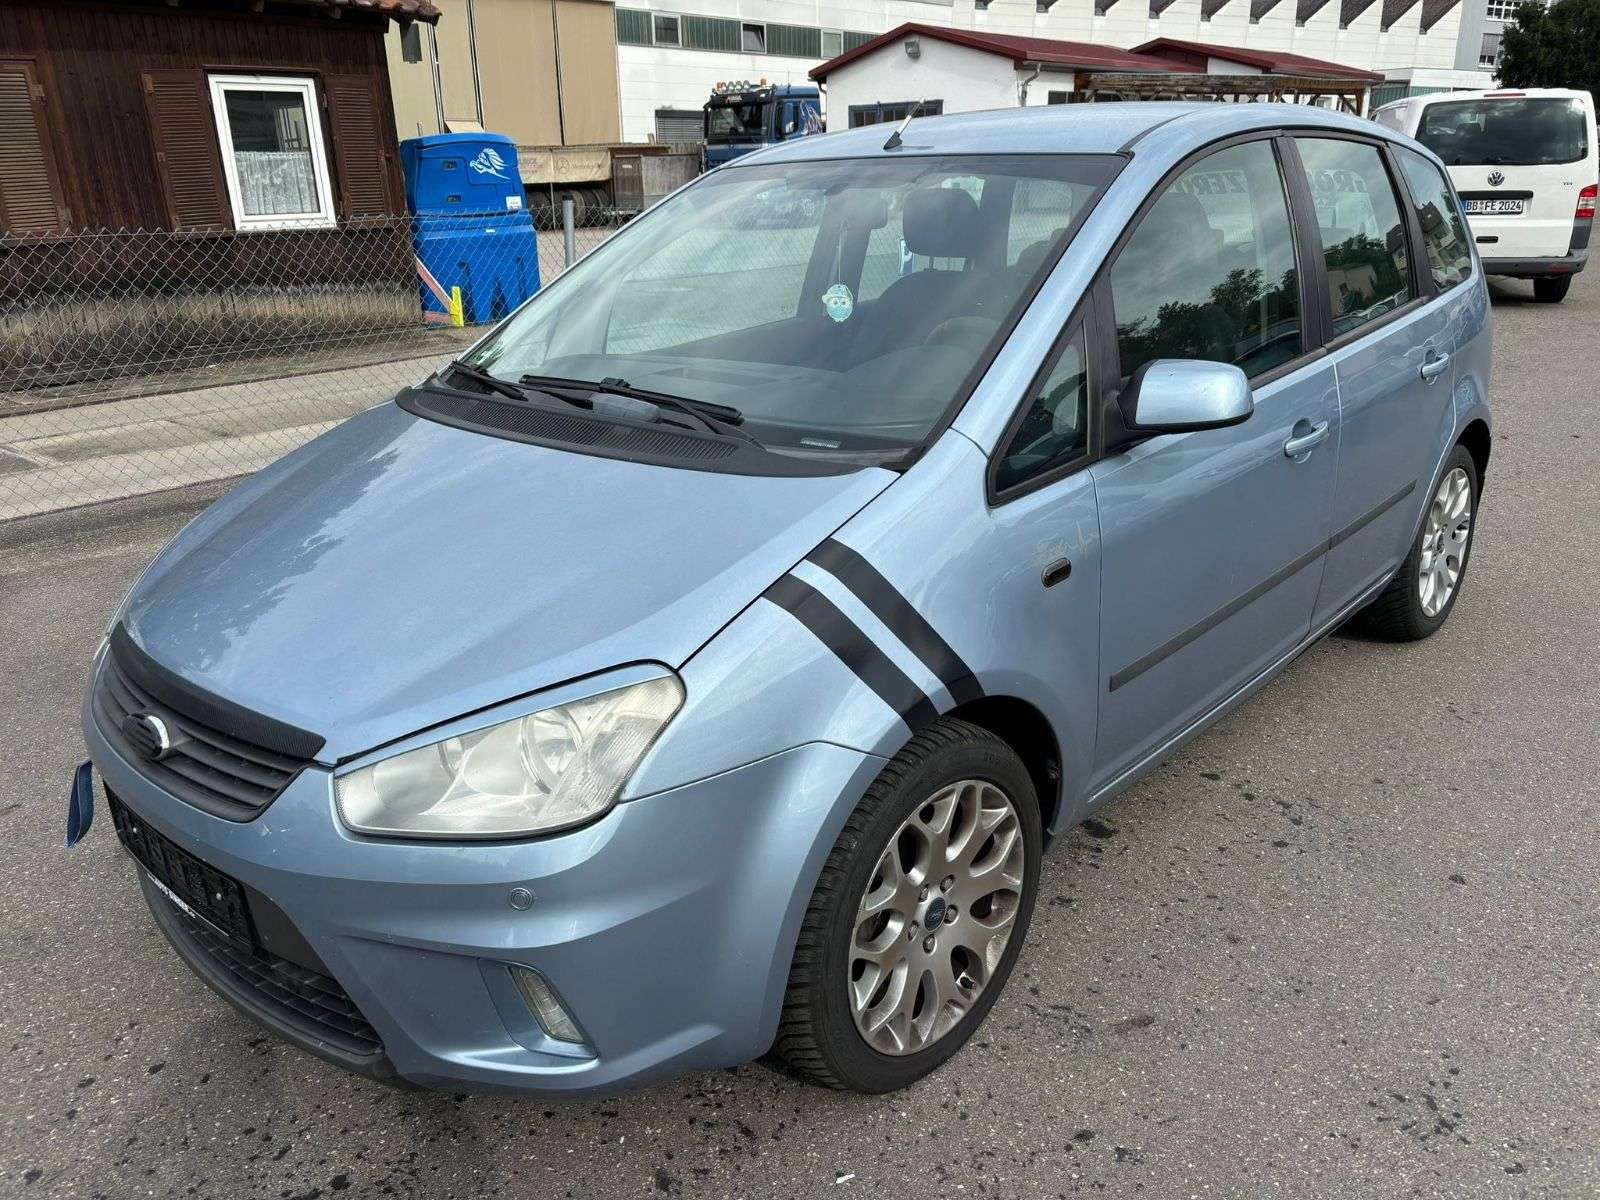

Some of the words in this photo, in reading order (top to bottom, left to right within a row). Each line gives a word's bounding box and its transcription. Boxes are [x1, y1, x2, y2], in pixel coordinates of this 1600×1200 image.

[1466, 200, 1479, 211] BB
[1485, 200, 1497, 211] FE
[1498, 200, 1521, 211] 2024
